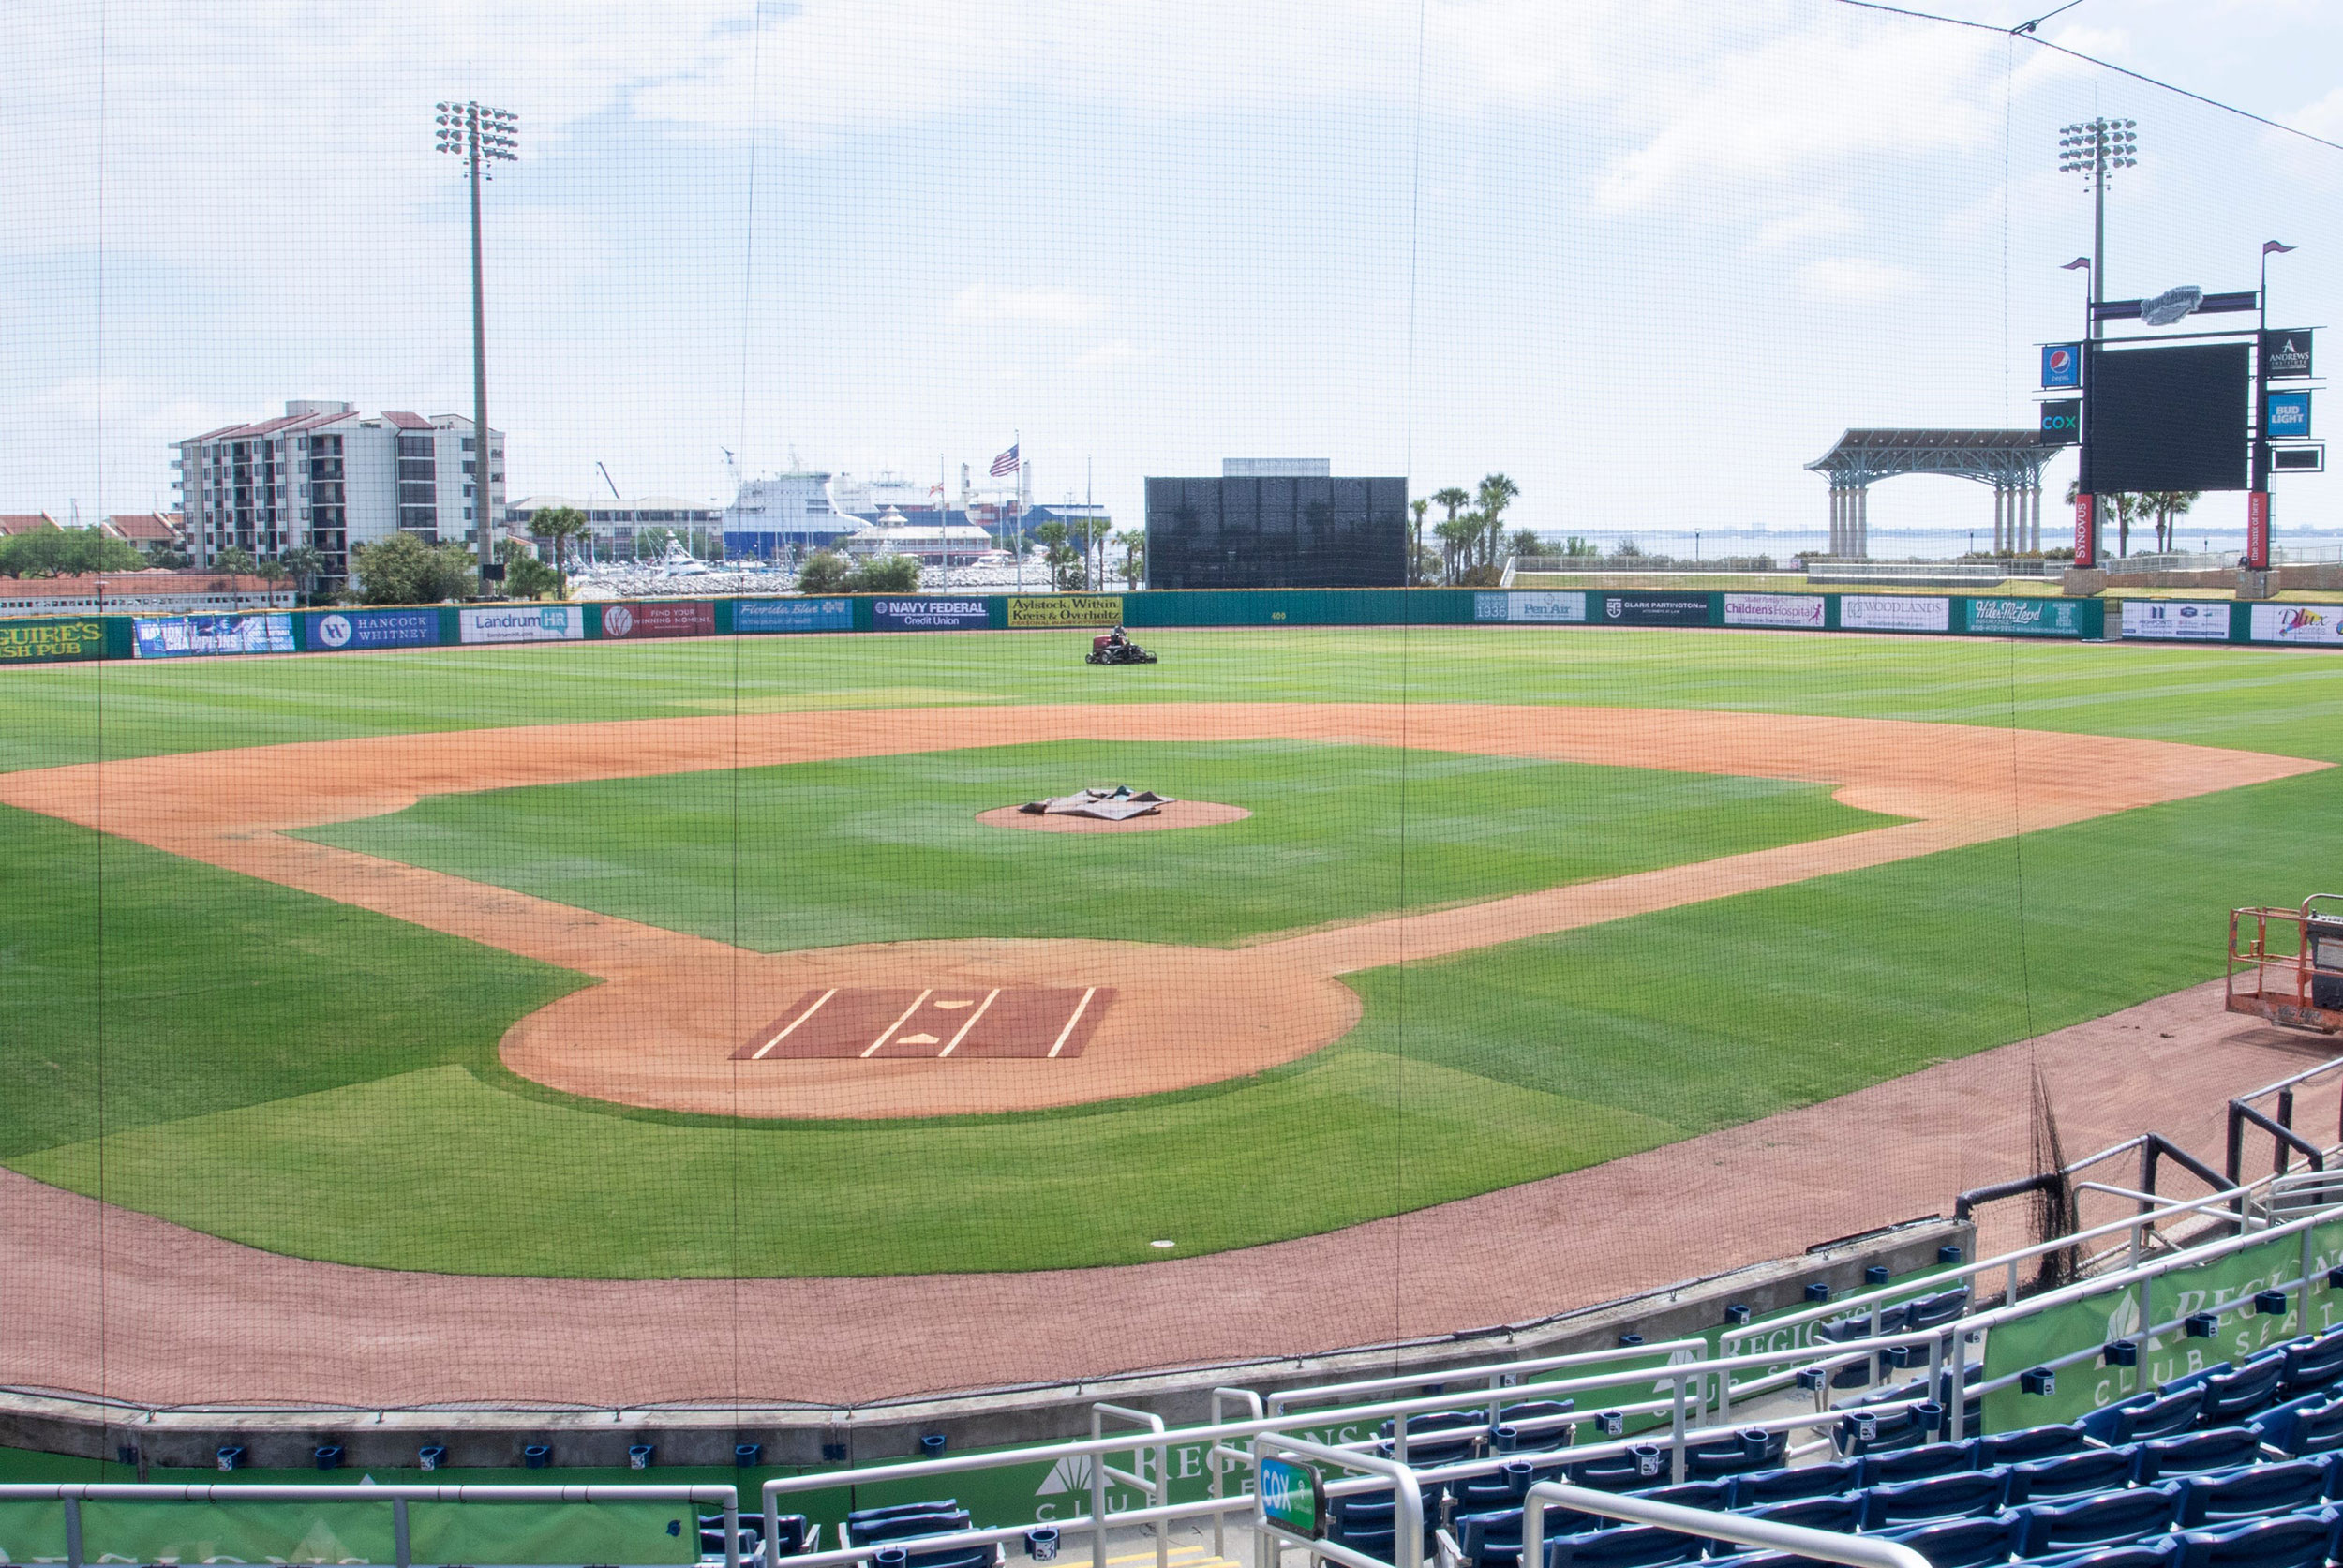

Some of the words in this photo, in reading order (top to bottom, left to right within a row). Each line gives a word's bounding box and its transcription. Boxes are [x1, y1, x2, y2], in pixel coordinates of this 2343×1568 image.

[2269, 352, 2310, 362] ANDREWS
[2276, 405, 2300, 415] BUD
[2042, 415, 2076, 429] COX
[2271, 414, 2304, 424] LIGHT
[2076, 502, 2087, 558] SYNOVUS
[740, 603, 789, 615] Florida
[791, 603, 819, 614] Blue
[889, 602, 928, 613] NAVY
[929, 602, 987, 613] FEDERAL
[1477, 605, 1507, 618] 1936
[1725, 603, 1773, 615] Children's
[1774, 605, 1813, 618] Hospital
[1865, 601, 1942, 614] WOODLANDS
[904, 616, 932, 625] Credit
[933, 616, 960, 625] Union
[1012, 609, 1046, 620] Kreis
[1059, 609, 1121, 620] Overholtz
[358, 616, 428, 629] HANCOCK
[358, 629, 428, 641] WHITNEY
[37, 642, 82, 656] PUB
[1263, 1469, 1291, 1513] COX
